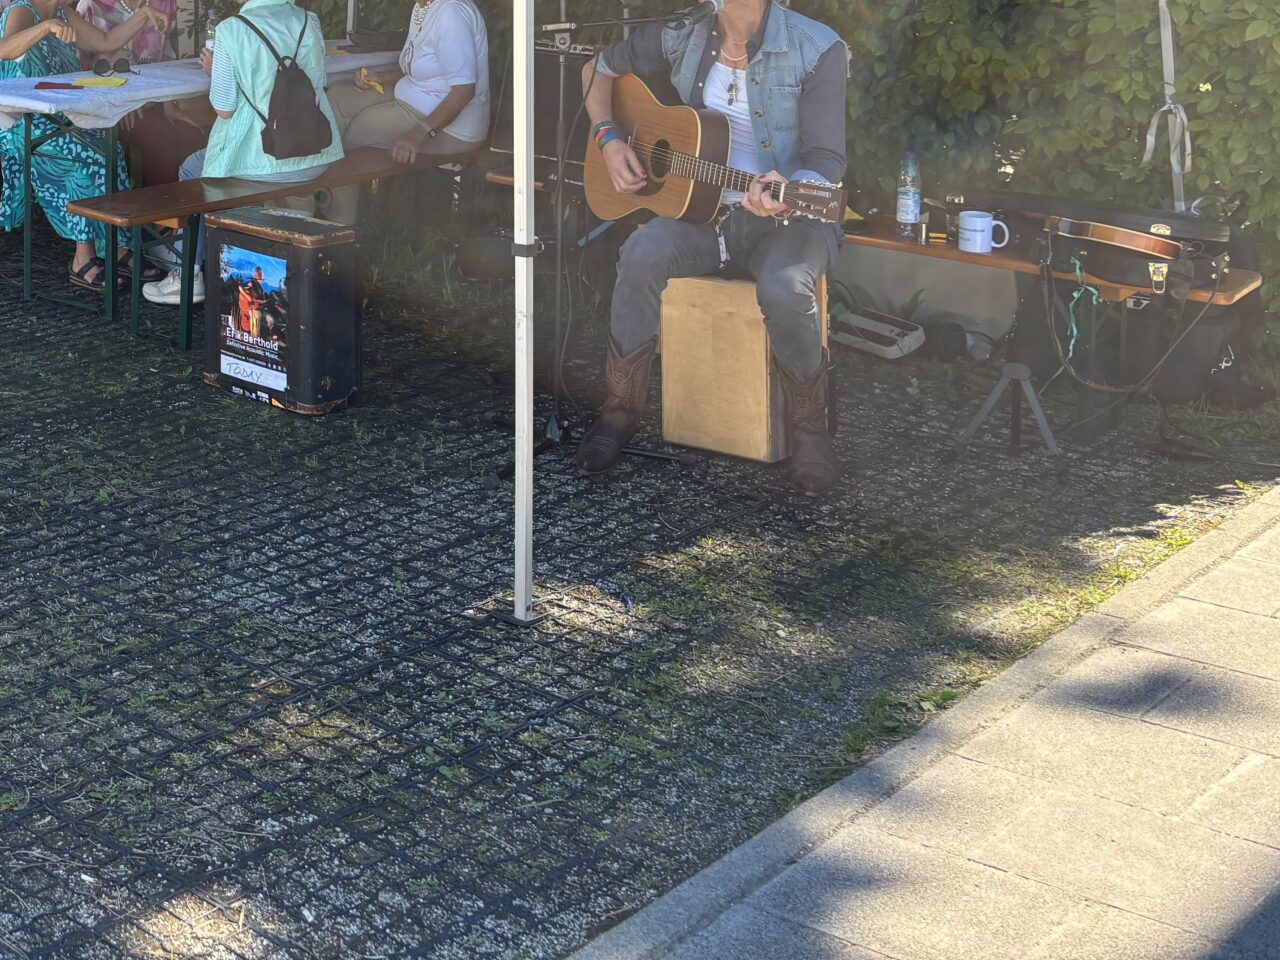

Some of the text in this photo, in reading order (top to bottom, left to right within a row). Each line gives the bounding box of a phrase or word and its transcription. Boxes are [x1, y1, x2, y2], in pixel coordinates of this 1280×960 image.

[226, 327, 279, 351] Erik Berthold
[265, 351, 279, 360] Music
[226, 362, 263, 383] TODAY
